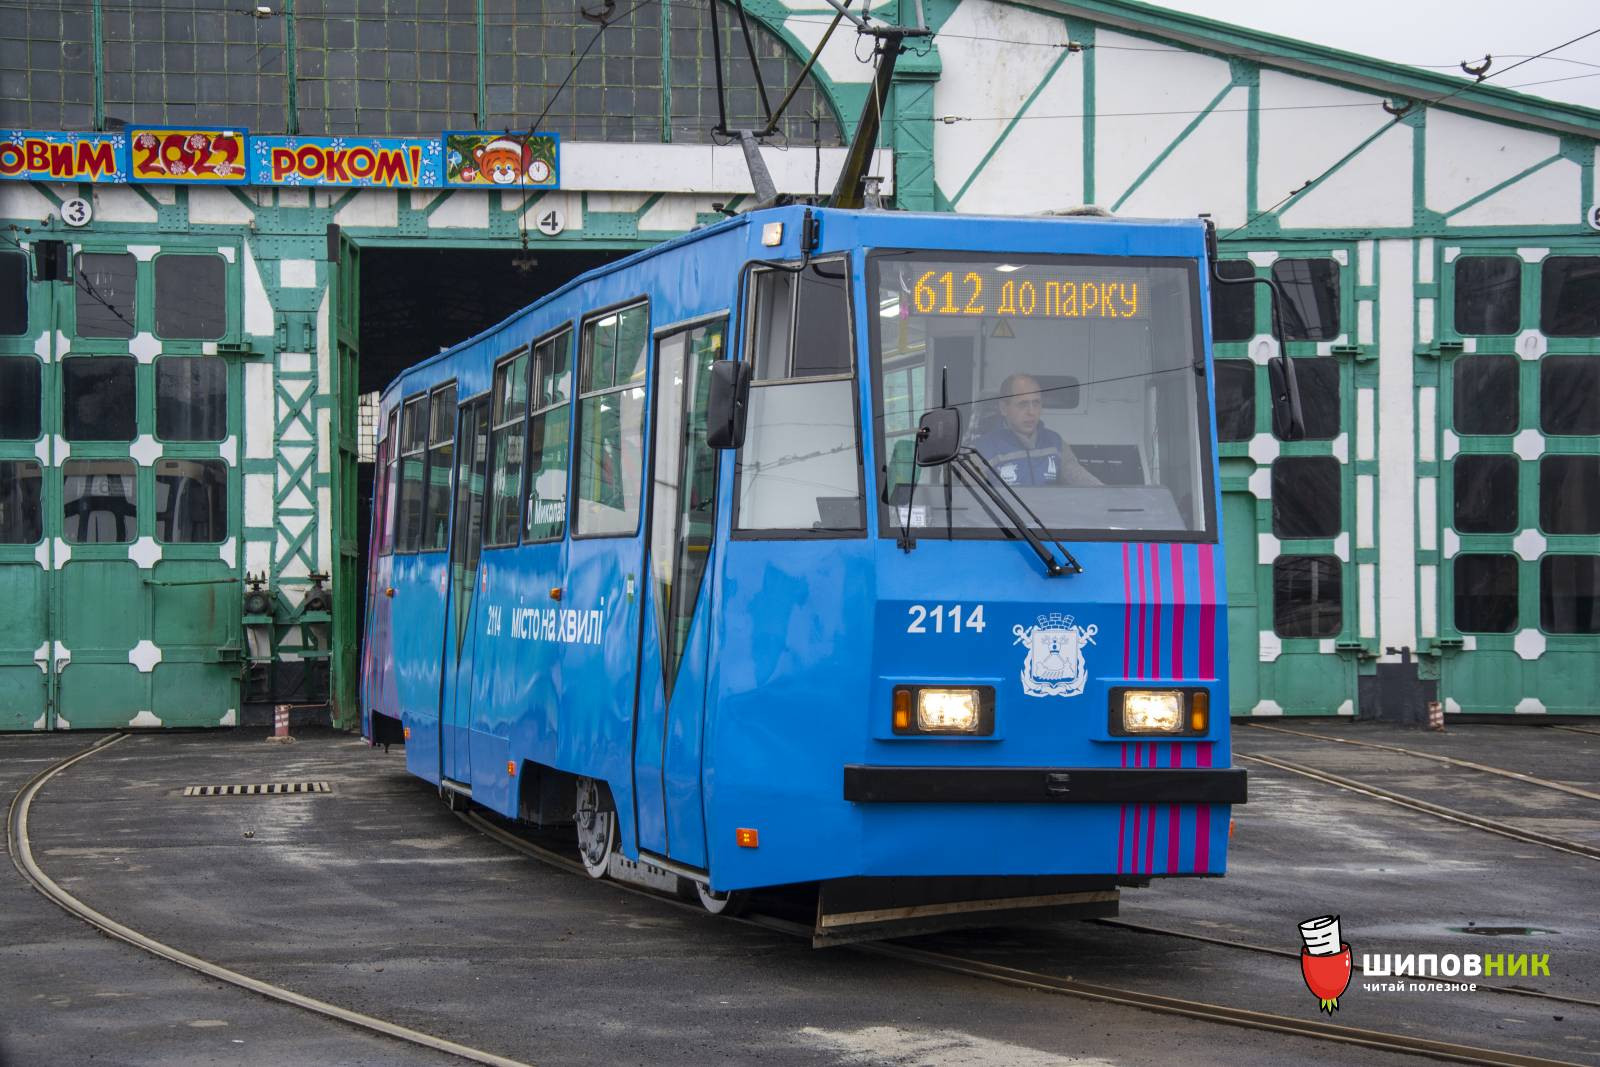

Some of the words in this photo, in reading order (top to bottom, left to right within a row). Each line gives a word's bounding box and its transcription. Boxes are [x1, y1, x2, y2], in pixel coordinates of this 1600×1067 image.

[132, 132, 245, 177] 2022
[271, 144, 421, 187] РОКОМ!
[68, 200, 85, 222] 3
[540, 210, 559, 231] 4
[914, 271, 984, 313] 612
[487, 605, 501, 636] 2114
[541, 608, 556, 642] на
[906, 605, 986, 633] 2114
